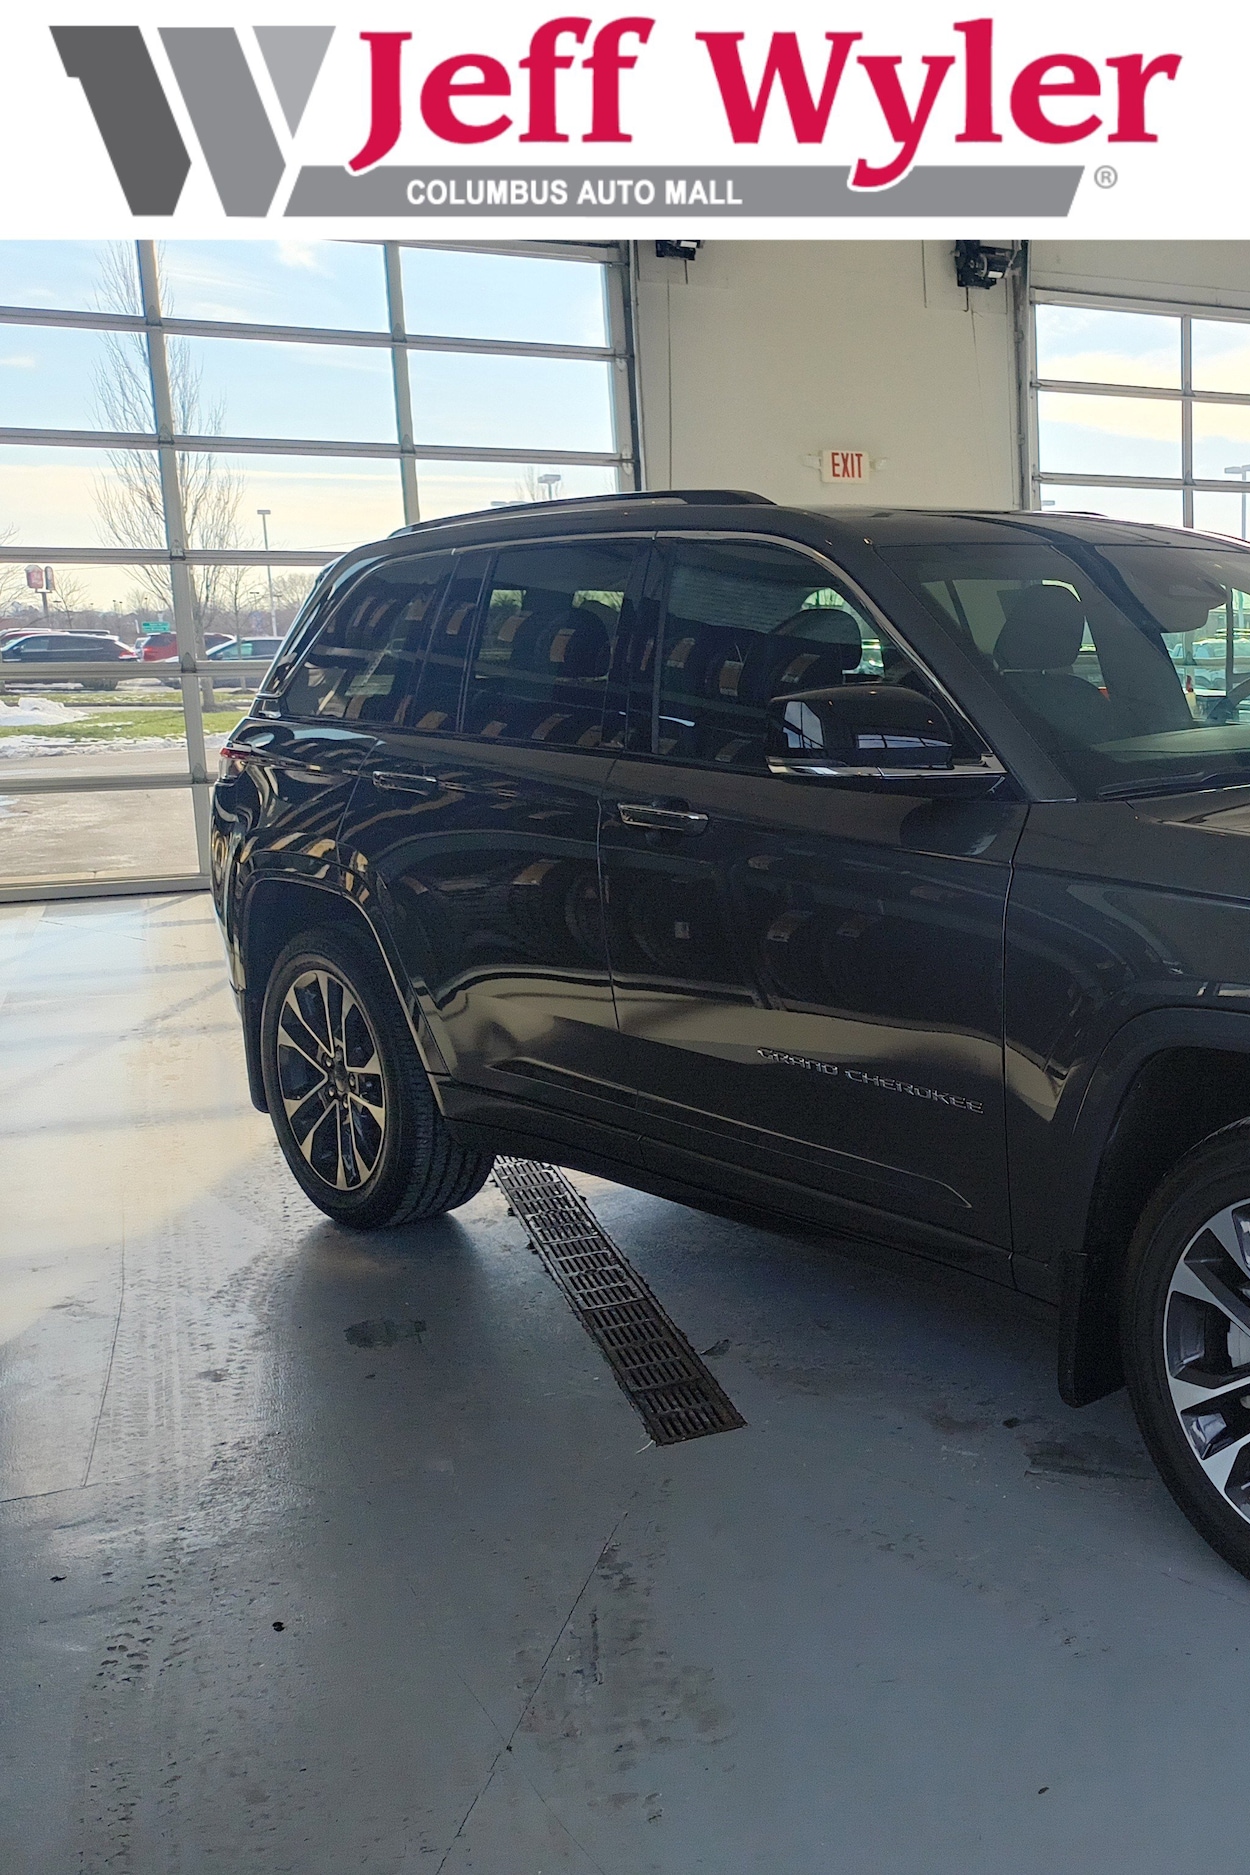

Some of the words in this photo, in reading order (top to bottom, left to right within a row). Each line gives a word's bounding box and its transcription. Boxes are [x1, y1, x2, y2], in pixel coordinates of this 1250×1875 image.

[831, 451, 863, 478] EXIT
[757, 1047, 839, 1077] GRAND
[844, 1069, 985, 1115] CHEROKEE
